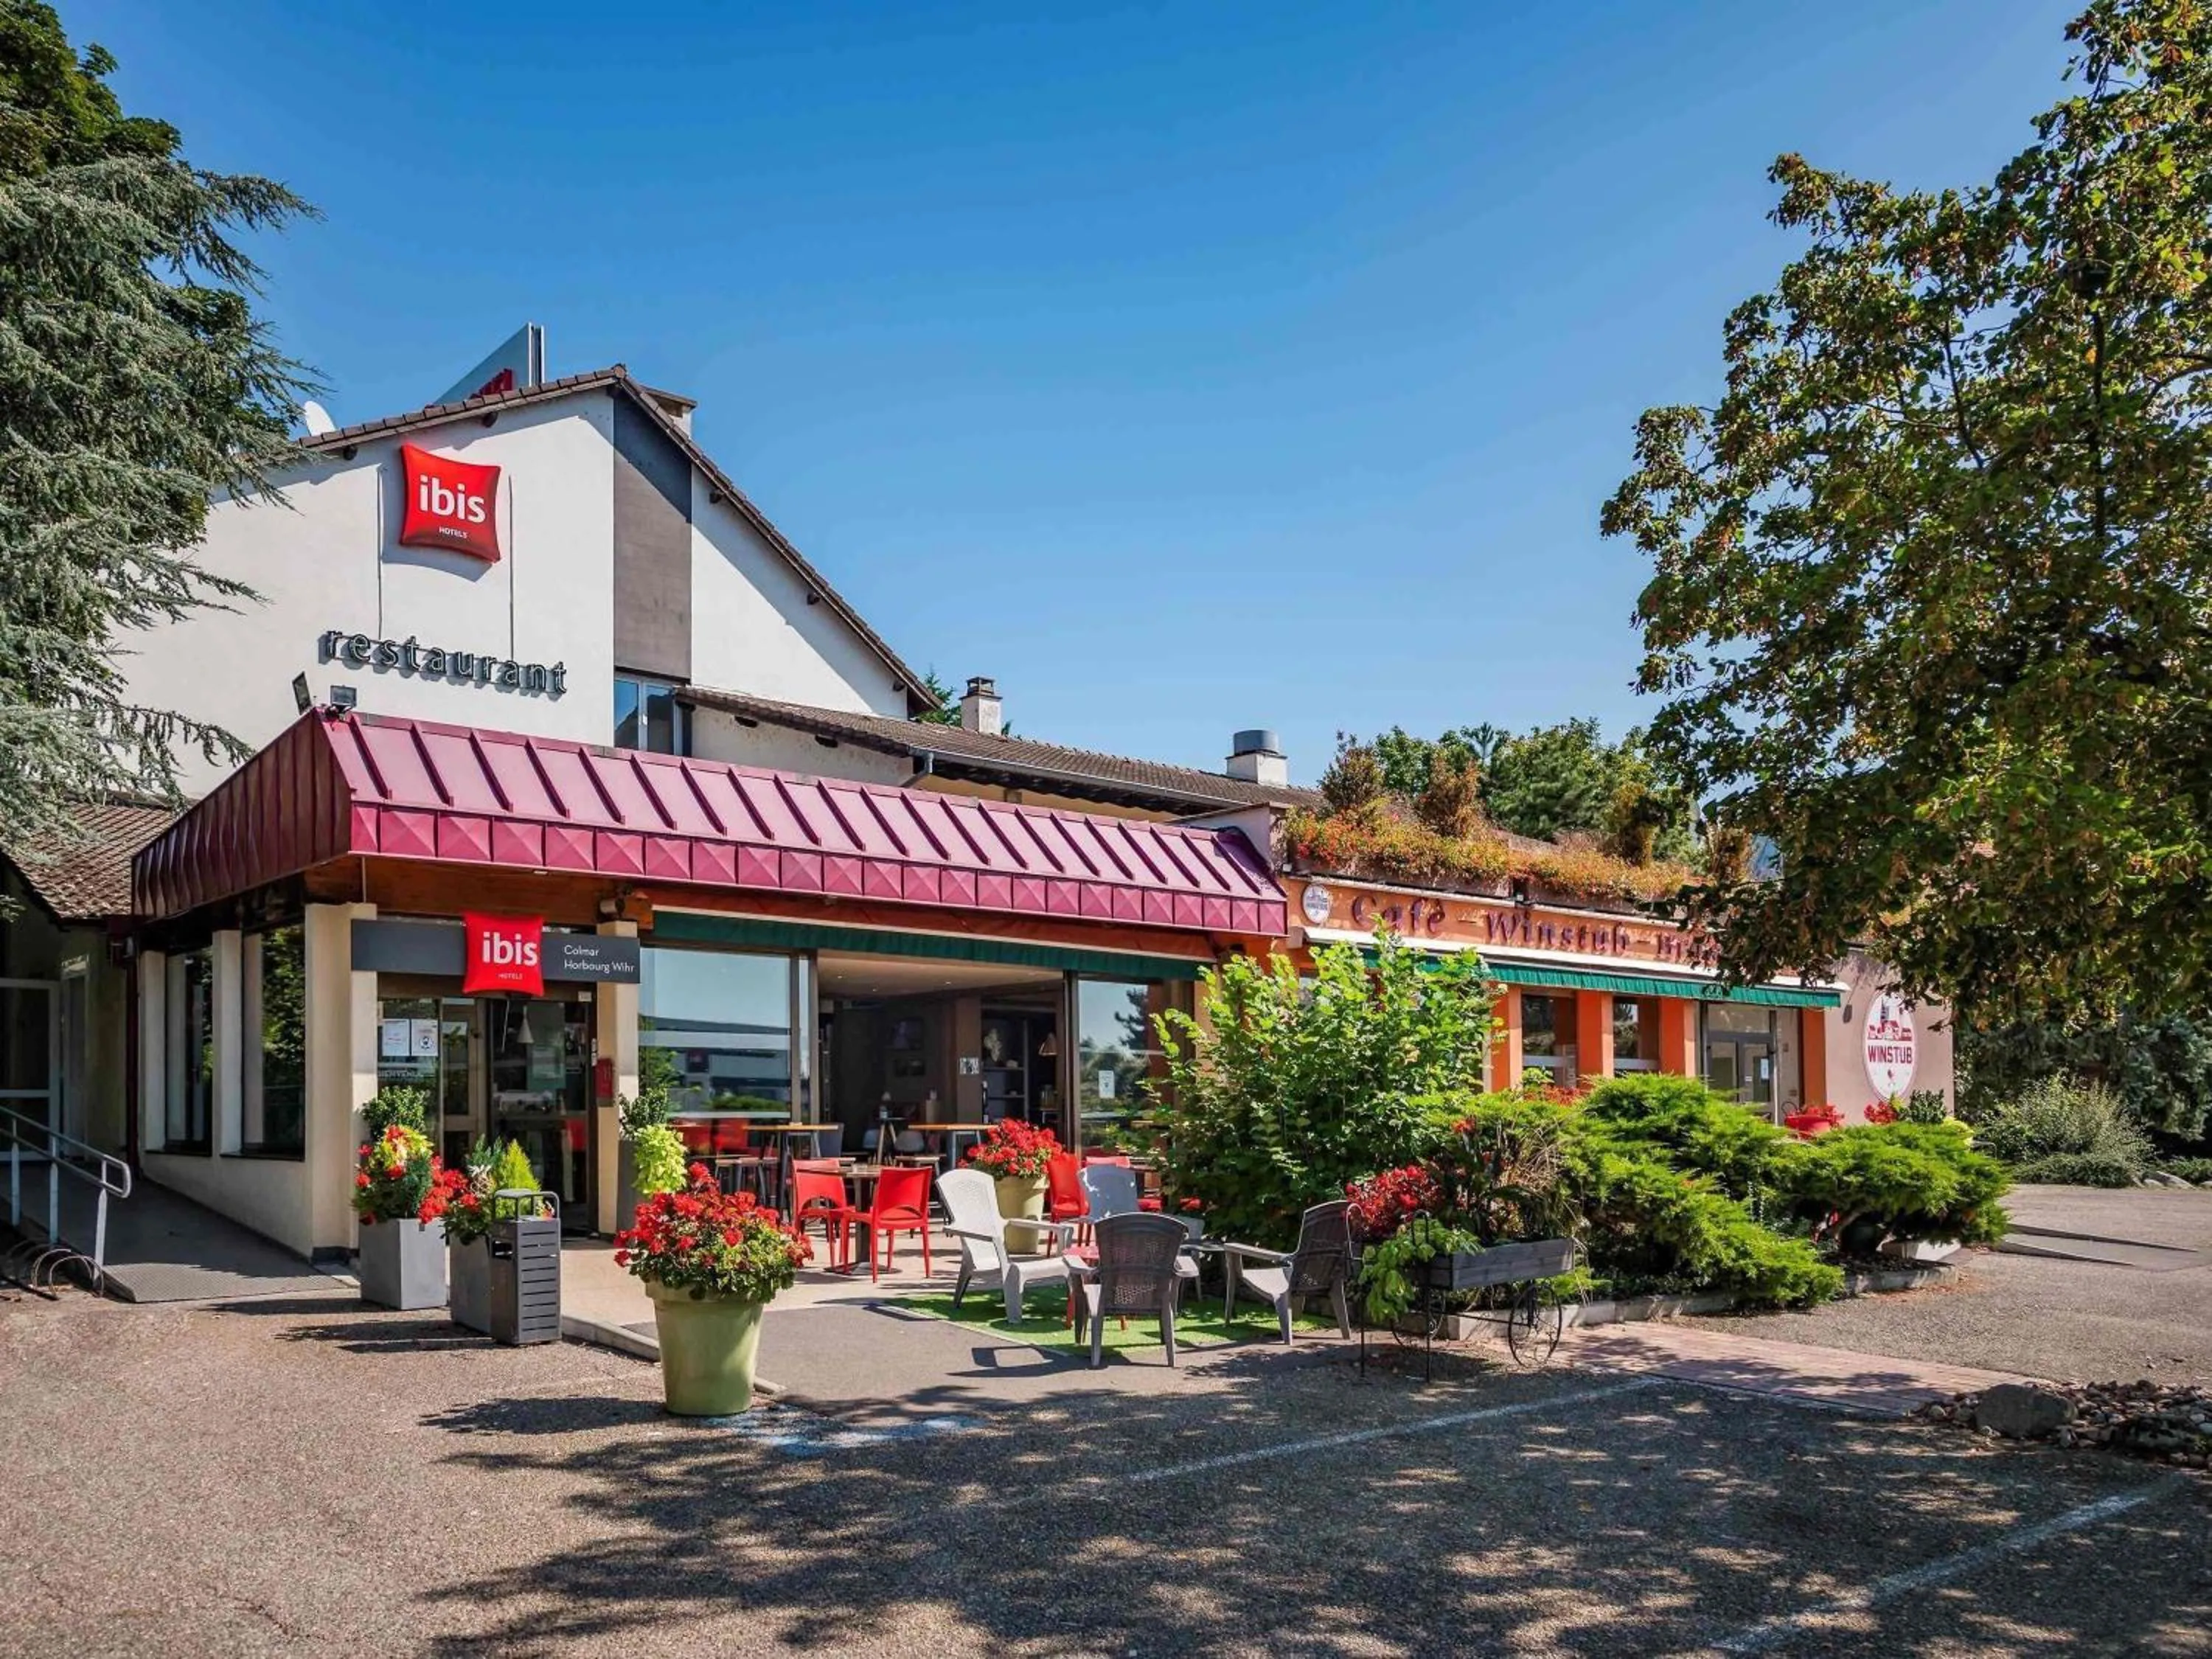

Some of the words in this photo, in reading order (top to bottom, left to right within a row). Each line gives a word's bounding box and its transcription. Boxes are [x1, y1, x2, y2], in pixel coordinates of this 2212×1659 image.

[420, 474, 485, 523] ibis
[439, 526, 468, 539] HOTELS
[325, 630, 567, 694] restaurant
[1486, 910, 1630, 952] Winstub
[482, 932, 538, 966] ibis
[563, 945, 599, 956] Colmar
[563, 960, 611, 973] Horbourg
[611, 961, 635, 973] Wihr
[1868, 1045, 1913, 1064] WINSTUB
